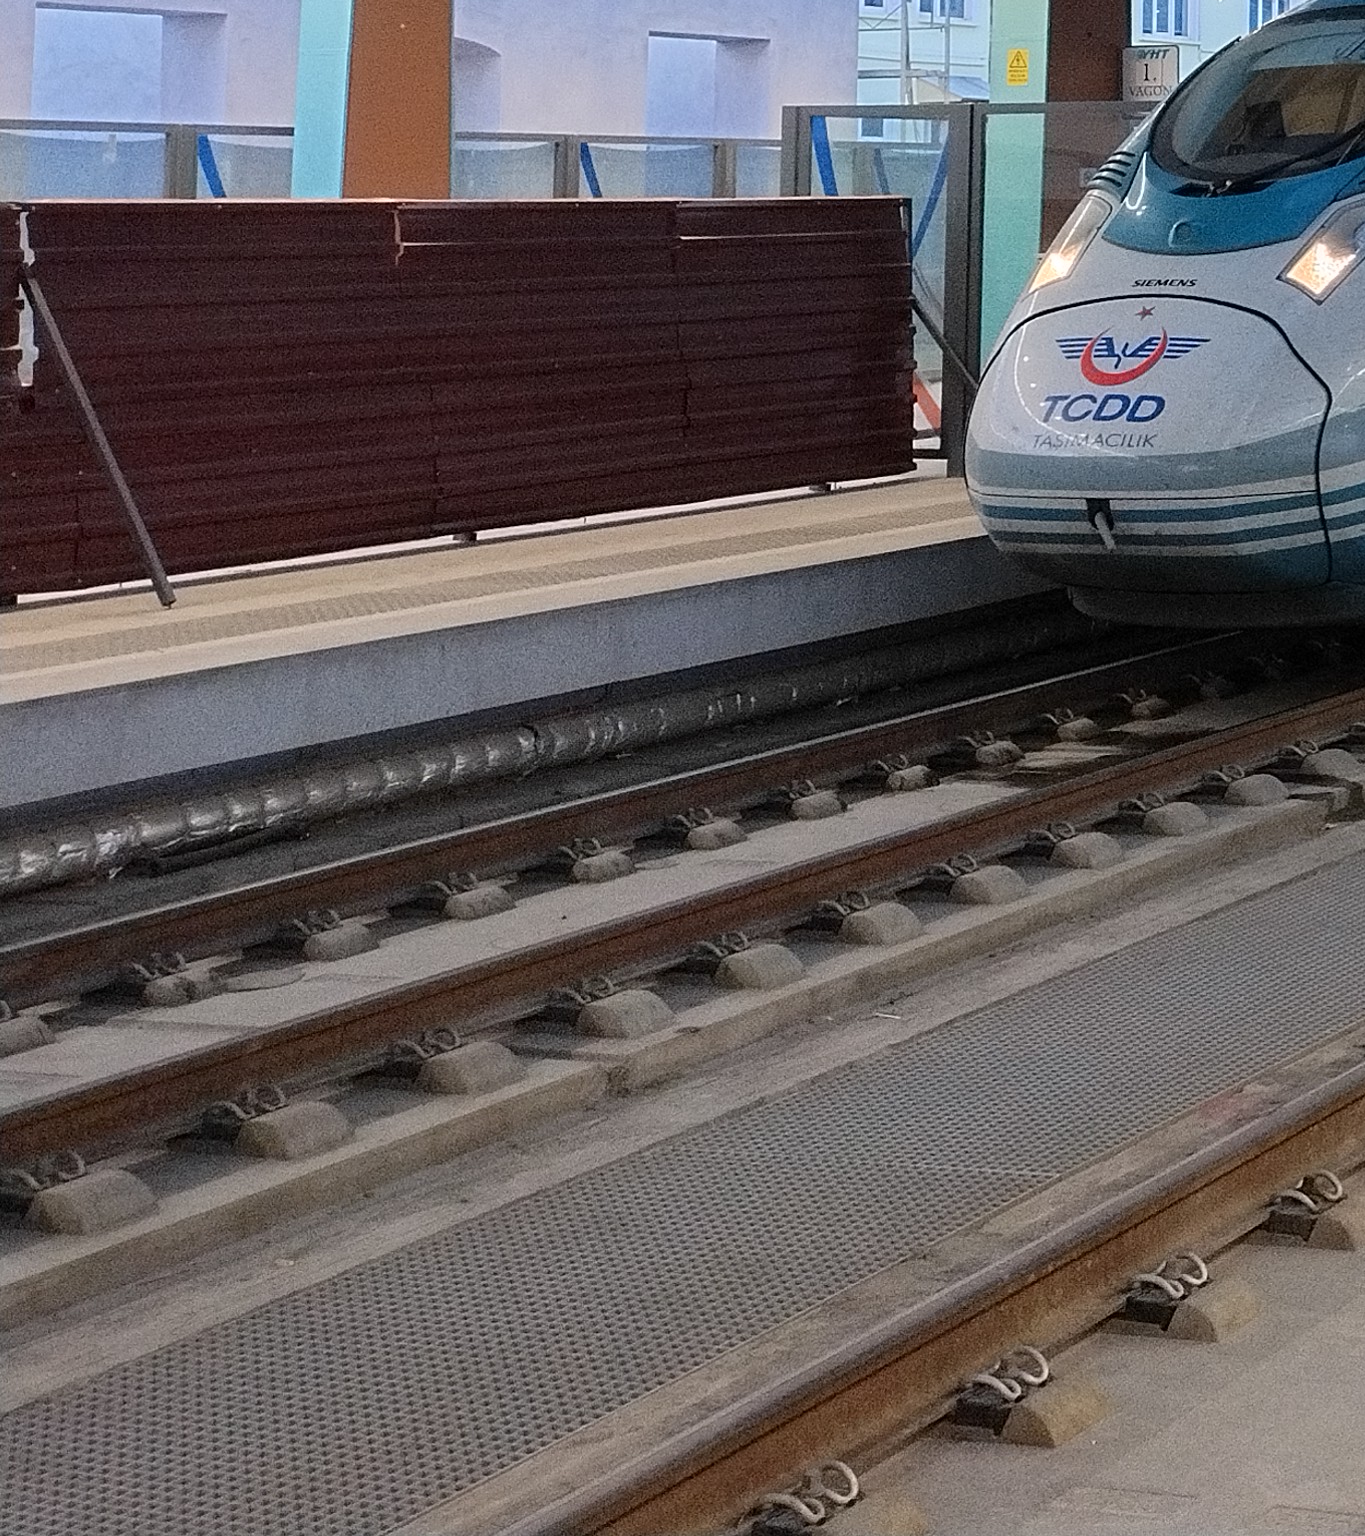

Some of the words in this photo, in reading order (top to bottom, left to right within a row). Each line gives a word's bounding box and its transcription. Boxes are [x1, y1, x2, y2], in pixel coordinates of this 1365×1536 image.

[1137, 49, 1170, 59] YHT
[1144, 63, 1157, 81] 1.
[1129, 85, 1171, 97] VAGON
[1132, 279, 1198, 287] SIEMENS
[1042, 394, 1166, 422] TCDD
[1033, 433, 1158, 450] TAŞIMACILIK
